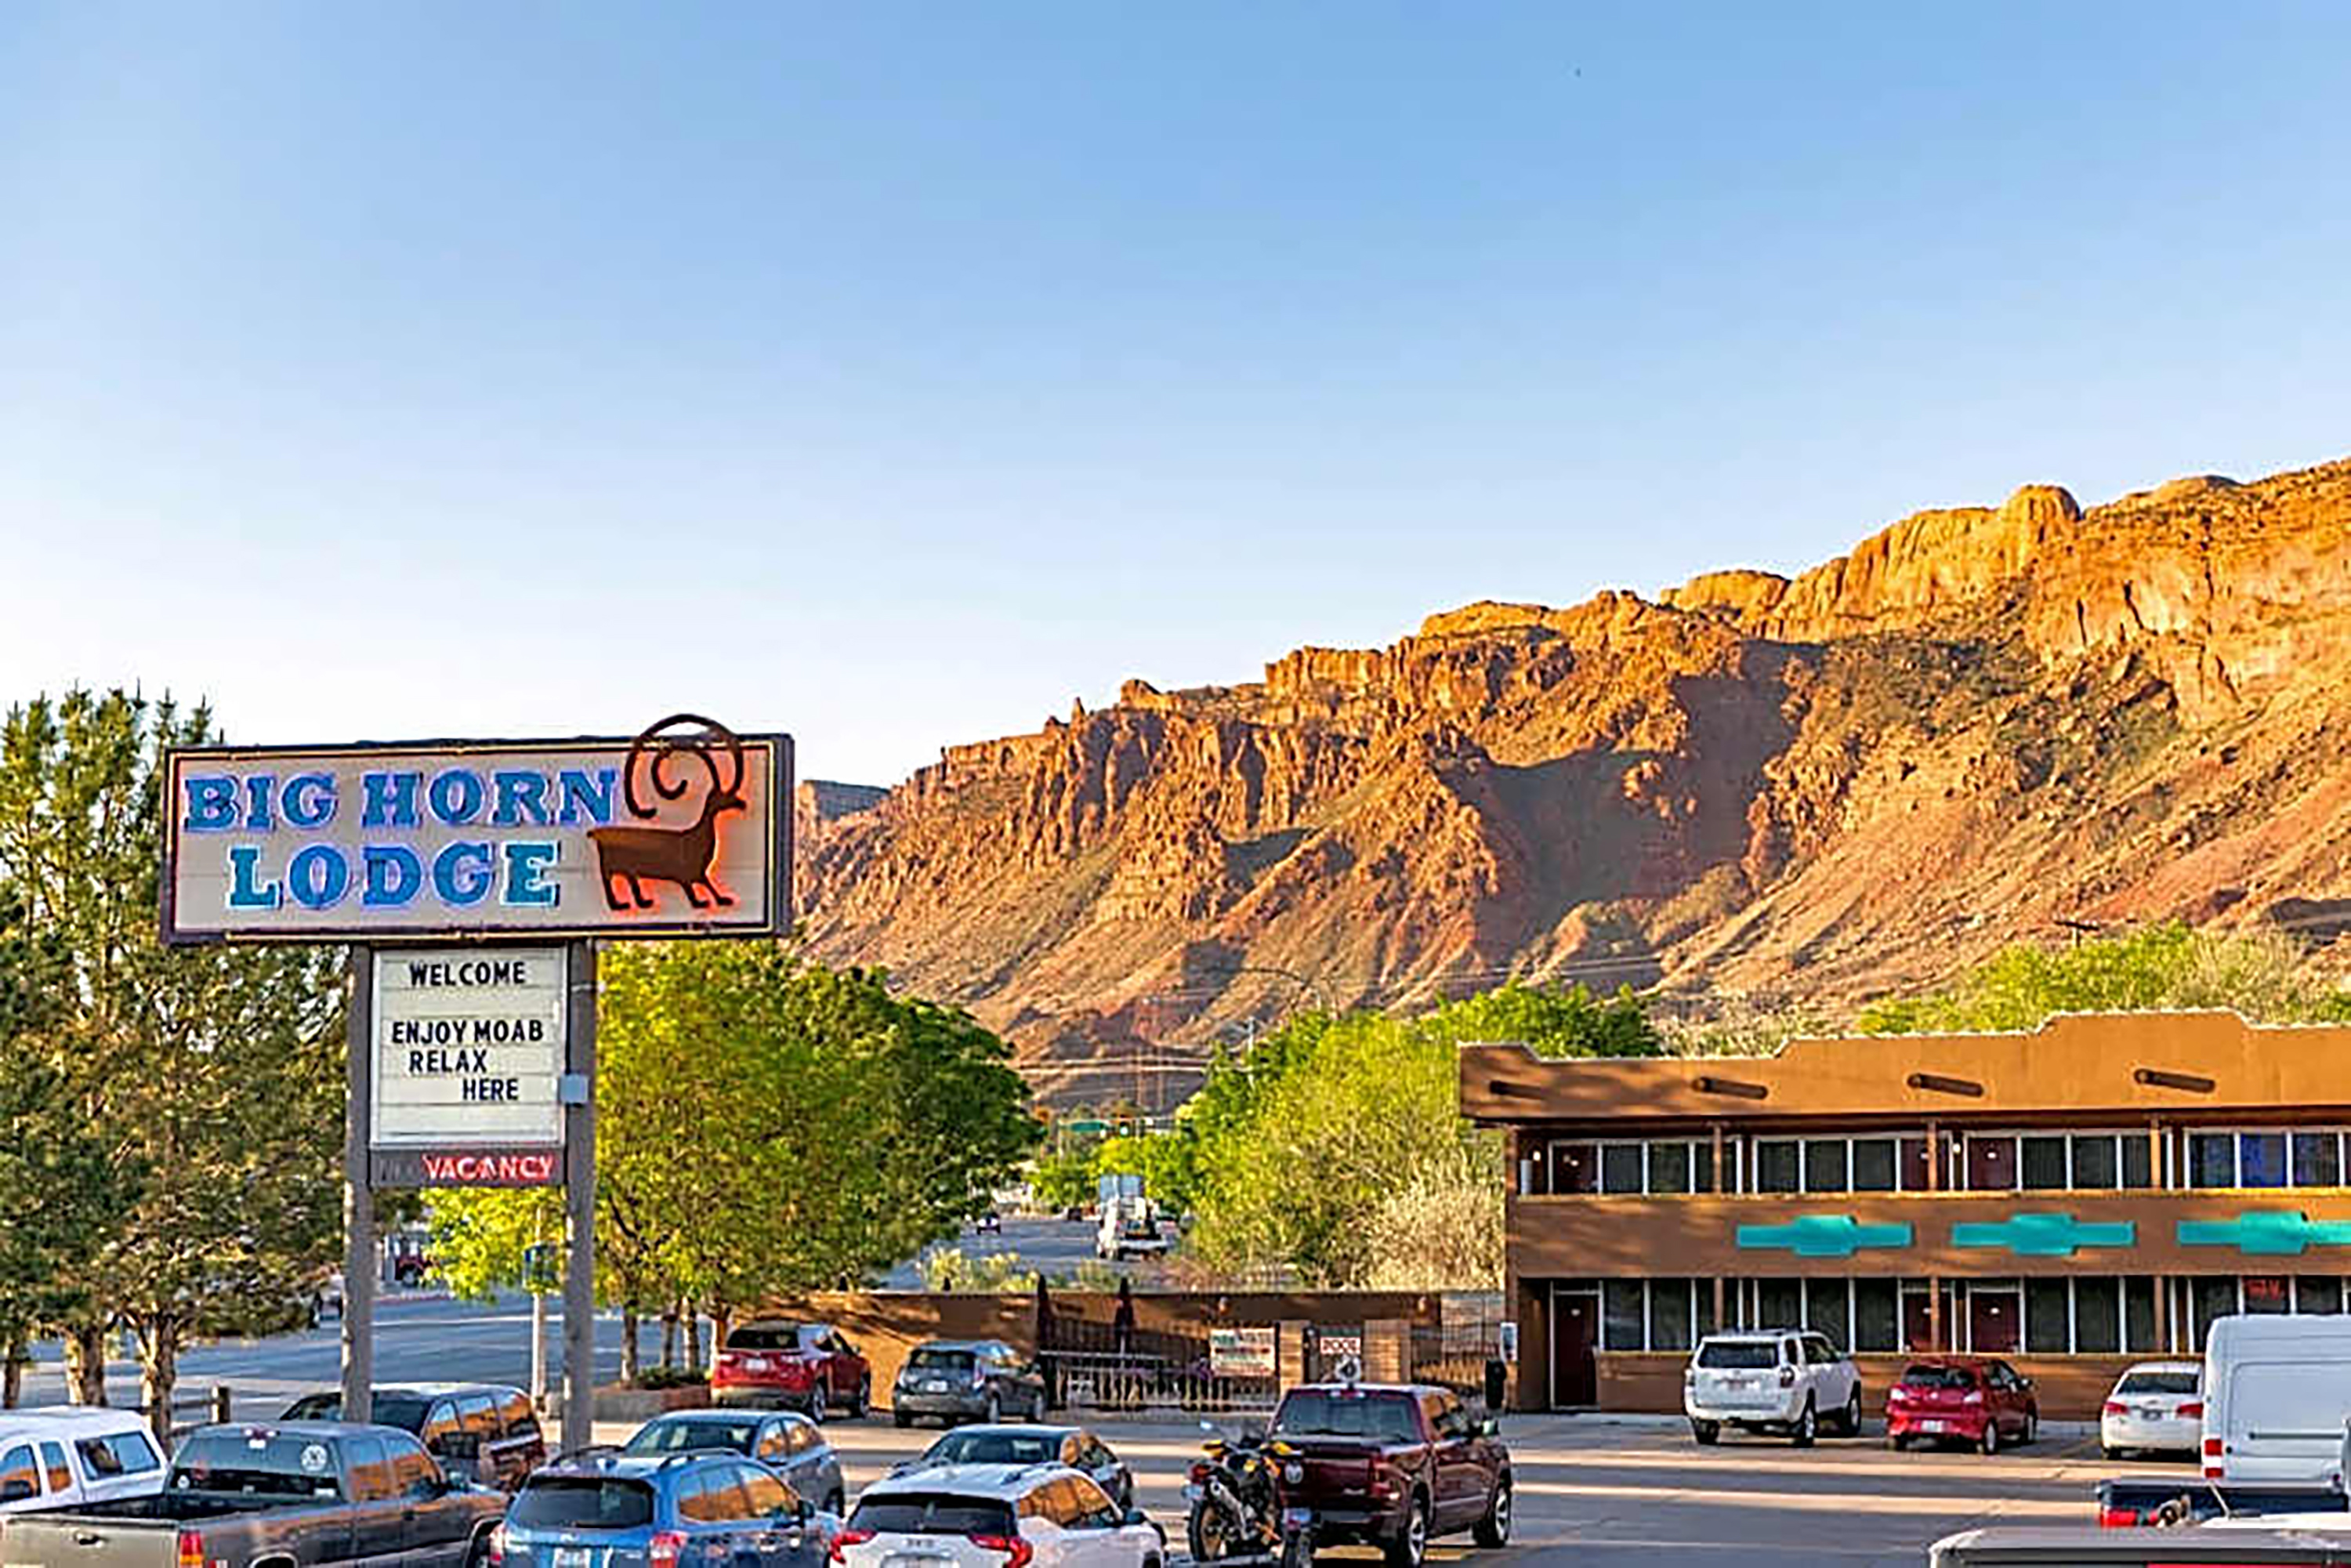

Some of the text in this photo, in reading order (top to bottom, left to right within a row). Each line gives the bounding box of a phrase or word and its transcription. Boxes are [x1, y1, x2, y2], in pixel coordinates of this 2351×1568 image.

[183, 766, 618, 831] BIG HORN
[226, 839, 560, 909] LODGE
[409, 961, 525, 987] WELCOME
[393, 1019, 543, 1044] ENJOY MOAB
[409, 1049, 487, 1073] RELAX
[462, 1078, 519, 1100] HERE
[421, 1154, 553, 1180] VACANCY
